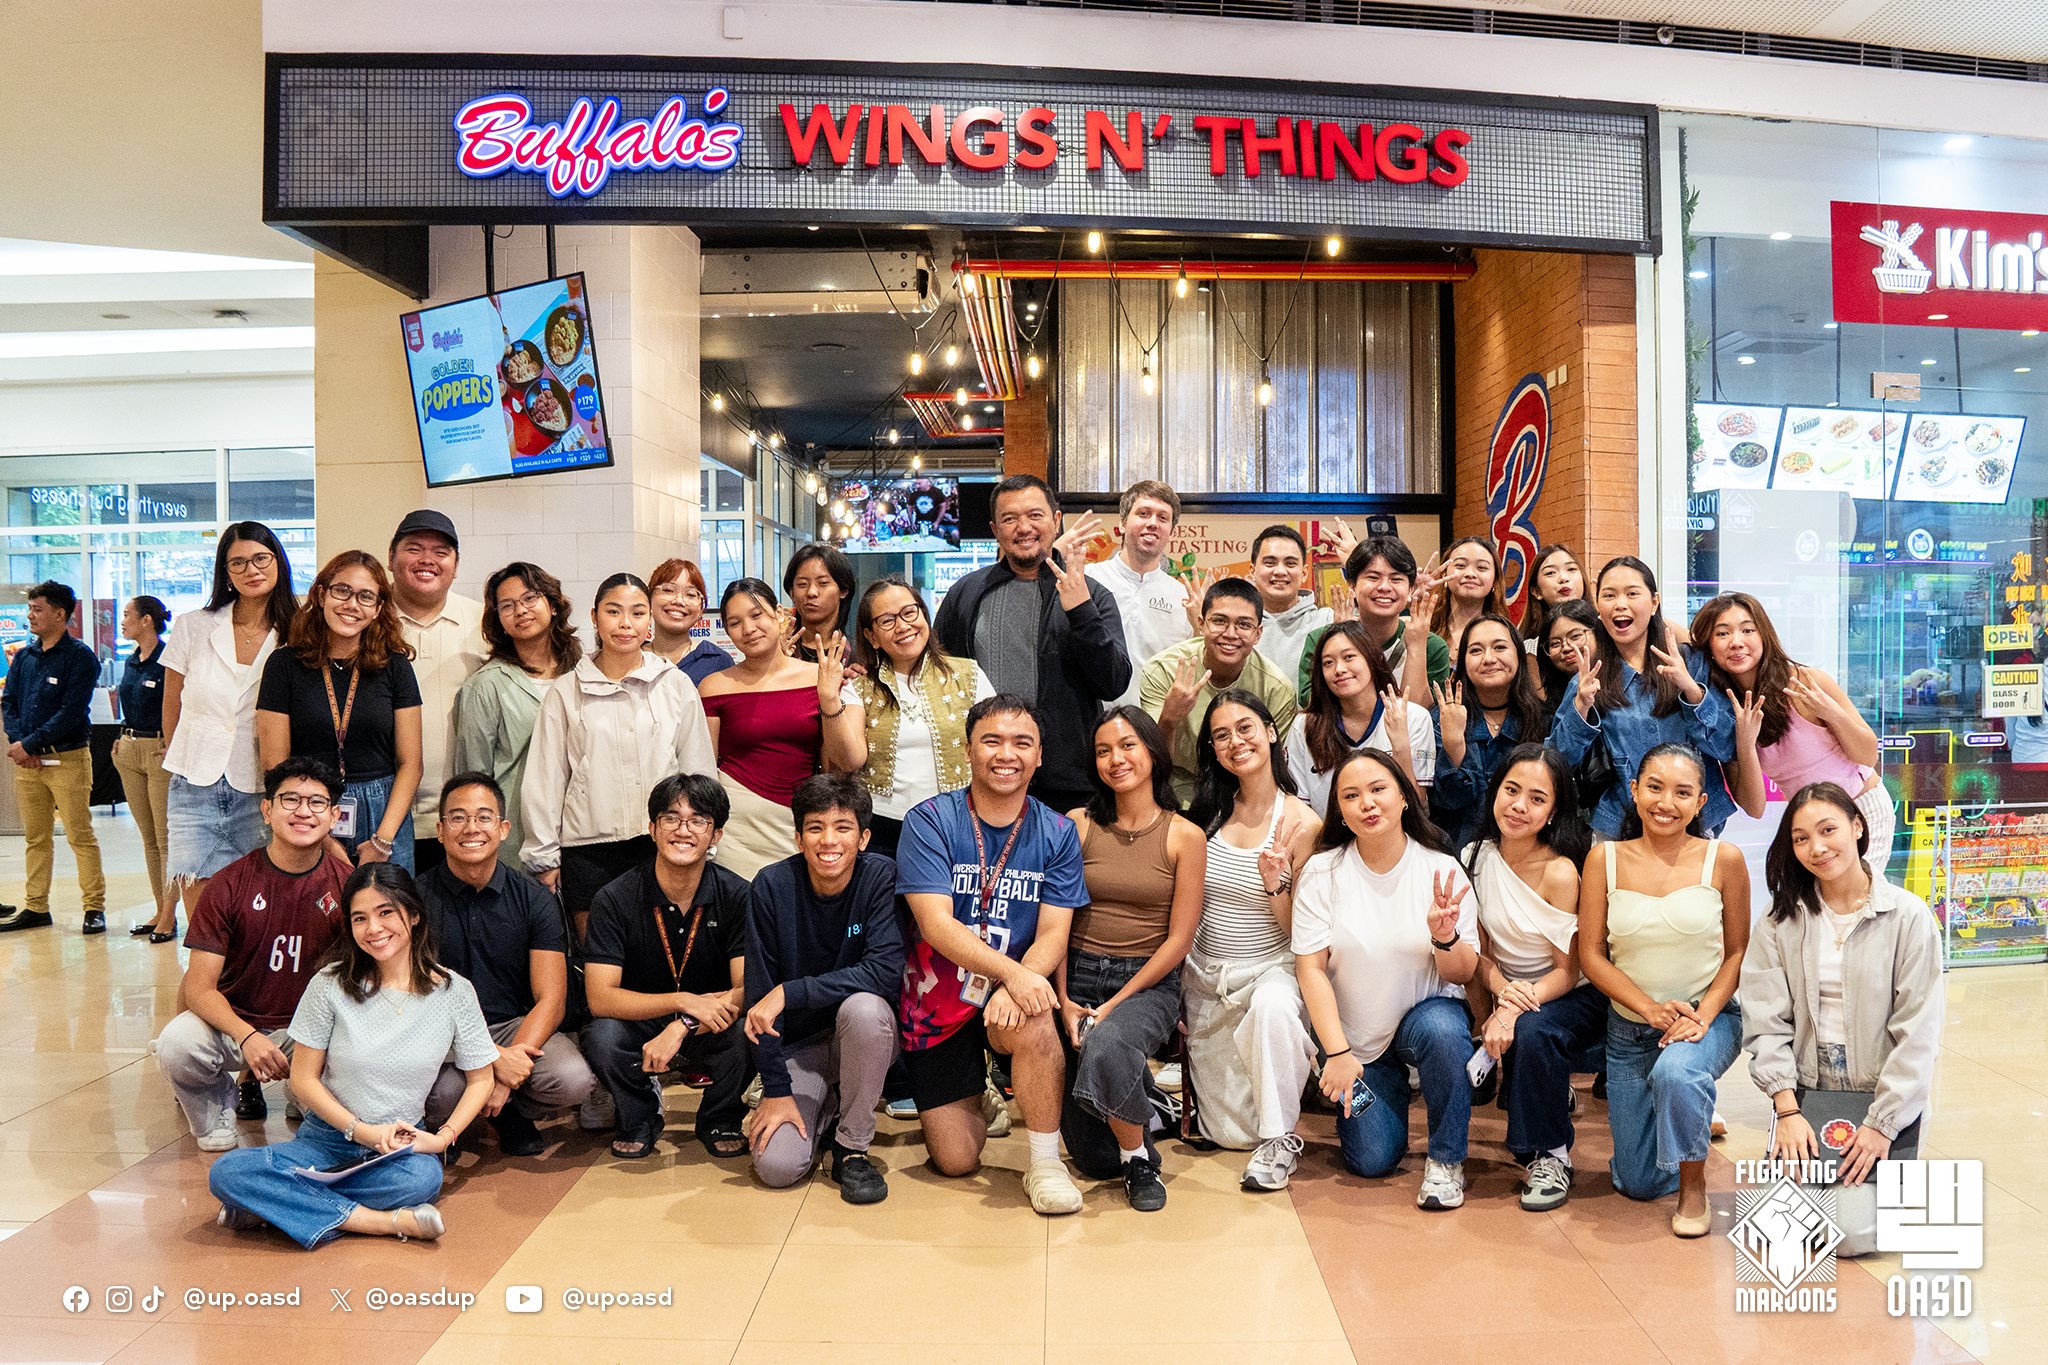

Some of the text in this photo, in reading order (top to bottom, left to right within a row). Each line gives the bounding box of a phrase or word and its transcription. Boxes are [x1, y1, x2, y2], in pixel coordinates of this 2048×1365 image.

[455, 87, 745, 198] Buffalo's
[778, 103, 1057, 171] WINGS
[1194, 114, 1473, 189] THINGS
[431, 358, 474, 380] GOLDEN
[422, 375, 494, 424] POPPERS
[1168, 540, 1248, 554] TASTING
[1988, 630, 2029, 645] OPEN
[1992, 671, 2038, 684] CAUTION
[1992, 690, 2018, 698] GLASS
[1992, 701, 2015, 709] DOOR
[970, 897, 1009, 920] CUB
[269, 934, 302, 973] 64
